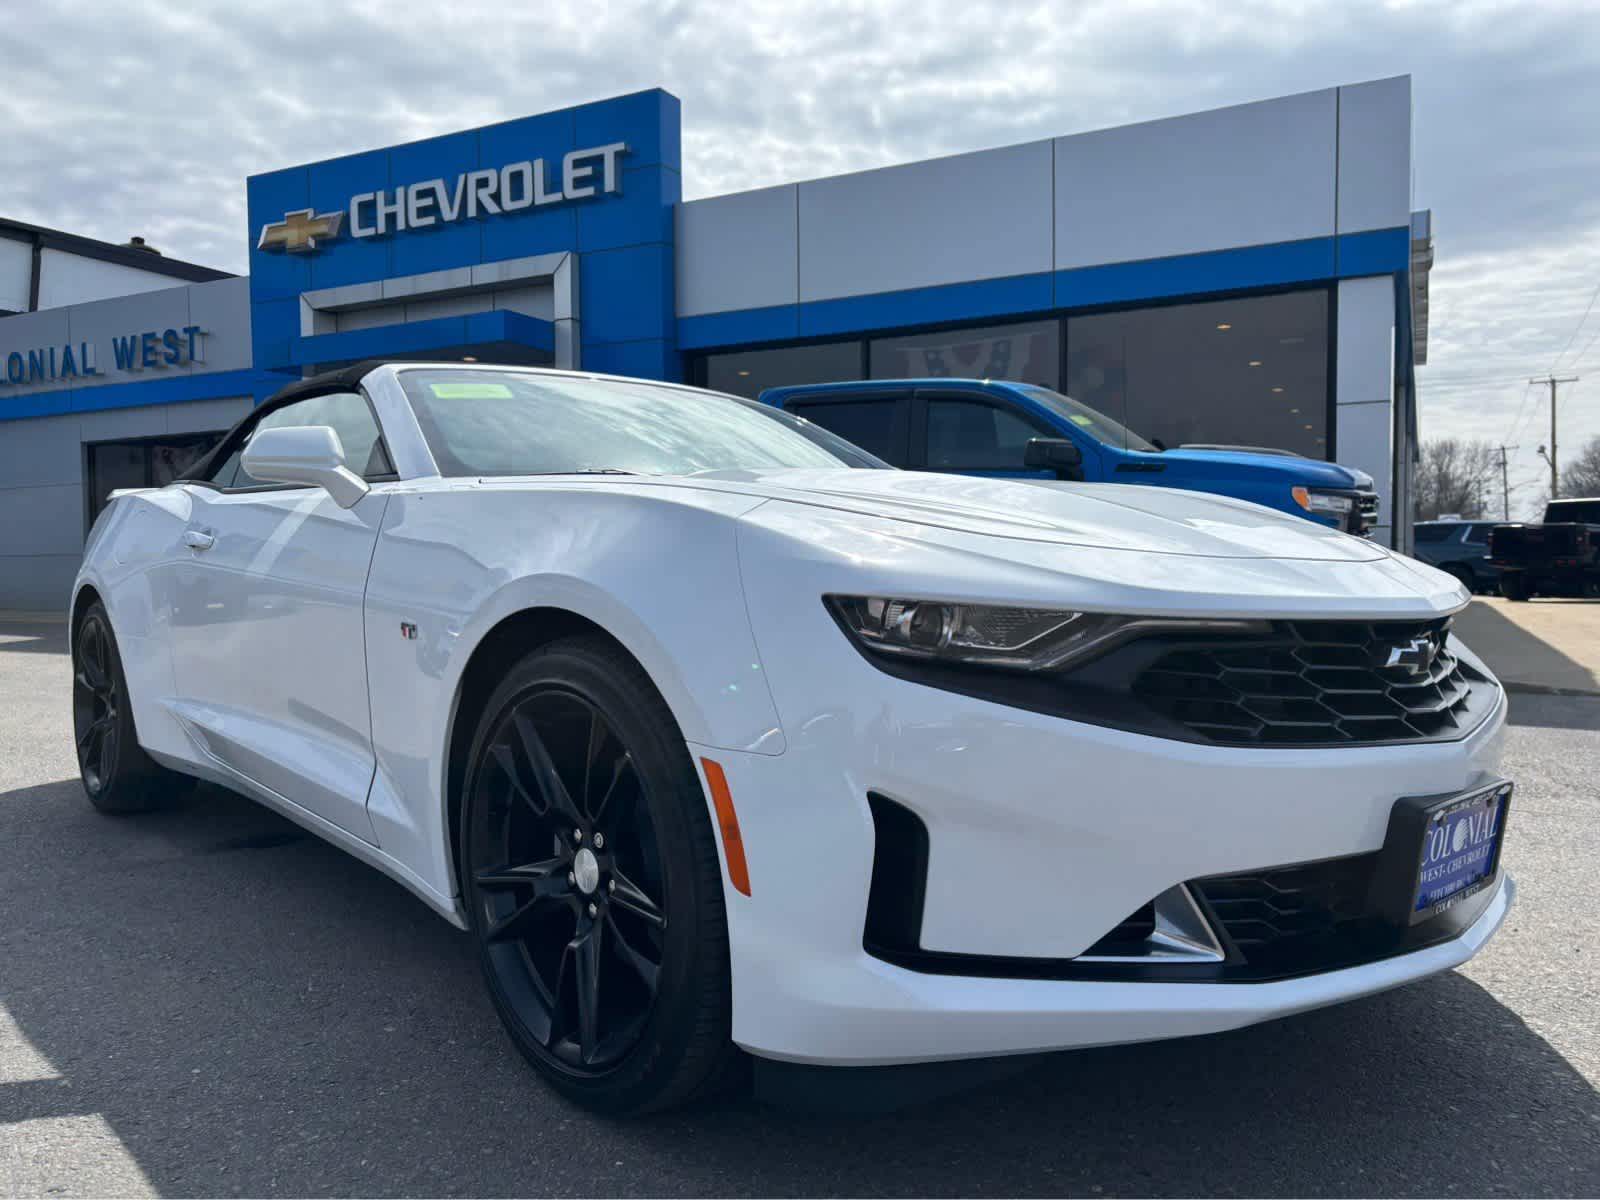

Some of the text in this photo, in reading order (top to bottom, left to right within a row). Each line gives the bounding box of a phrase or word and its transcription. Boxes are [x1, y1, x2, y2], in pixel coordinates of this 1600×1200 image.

[349, 141, 627, 238] CHEVROLET
[0, 326, 201, 384] ONIAL WEST
